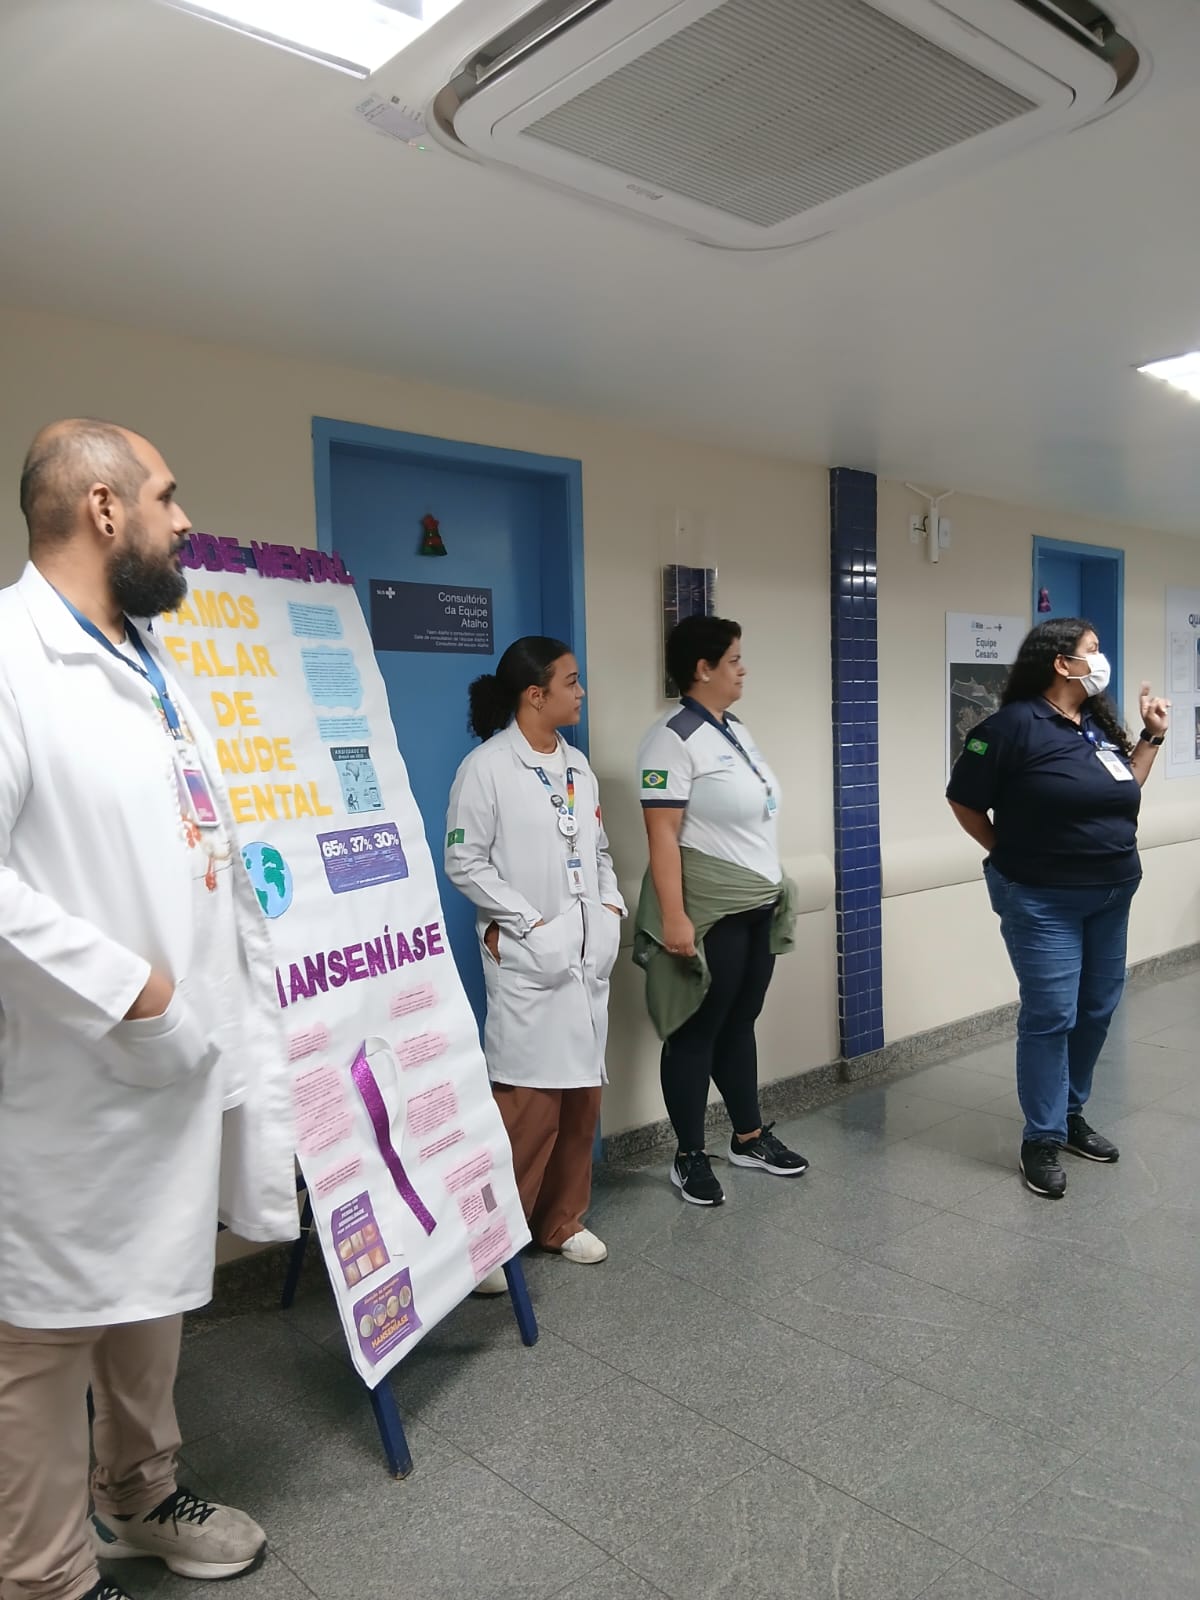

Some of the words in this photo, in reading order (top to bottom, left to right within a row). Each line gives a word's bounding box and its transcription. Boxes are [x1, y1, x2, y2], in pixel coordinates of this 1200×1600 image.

[180, 533, 247, 575] UDE
[250, 540, 355, 585] MENTAL
[438, 592, 488, 605] Consultório
[444, 606, 456, 615] da
[458, 606, 488, 618] Equipe
[461, 618, 488, 628] Atalho
[1188, 614, 1200, 628] QU
[976, 637, 997, 648] Equipe
[164, 636, 278, 677] FALAR
[210, 691, 261, 727] DE
[216, 729, 297, 774] AÚDE
[228, 781, 334, 824] ENTAL
[322, 839, 348, 857] 65%
[350, 835, 372, 853] 37%
[374, 831, 400, 849] 30%
